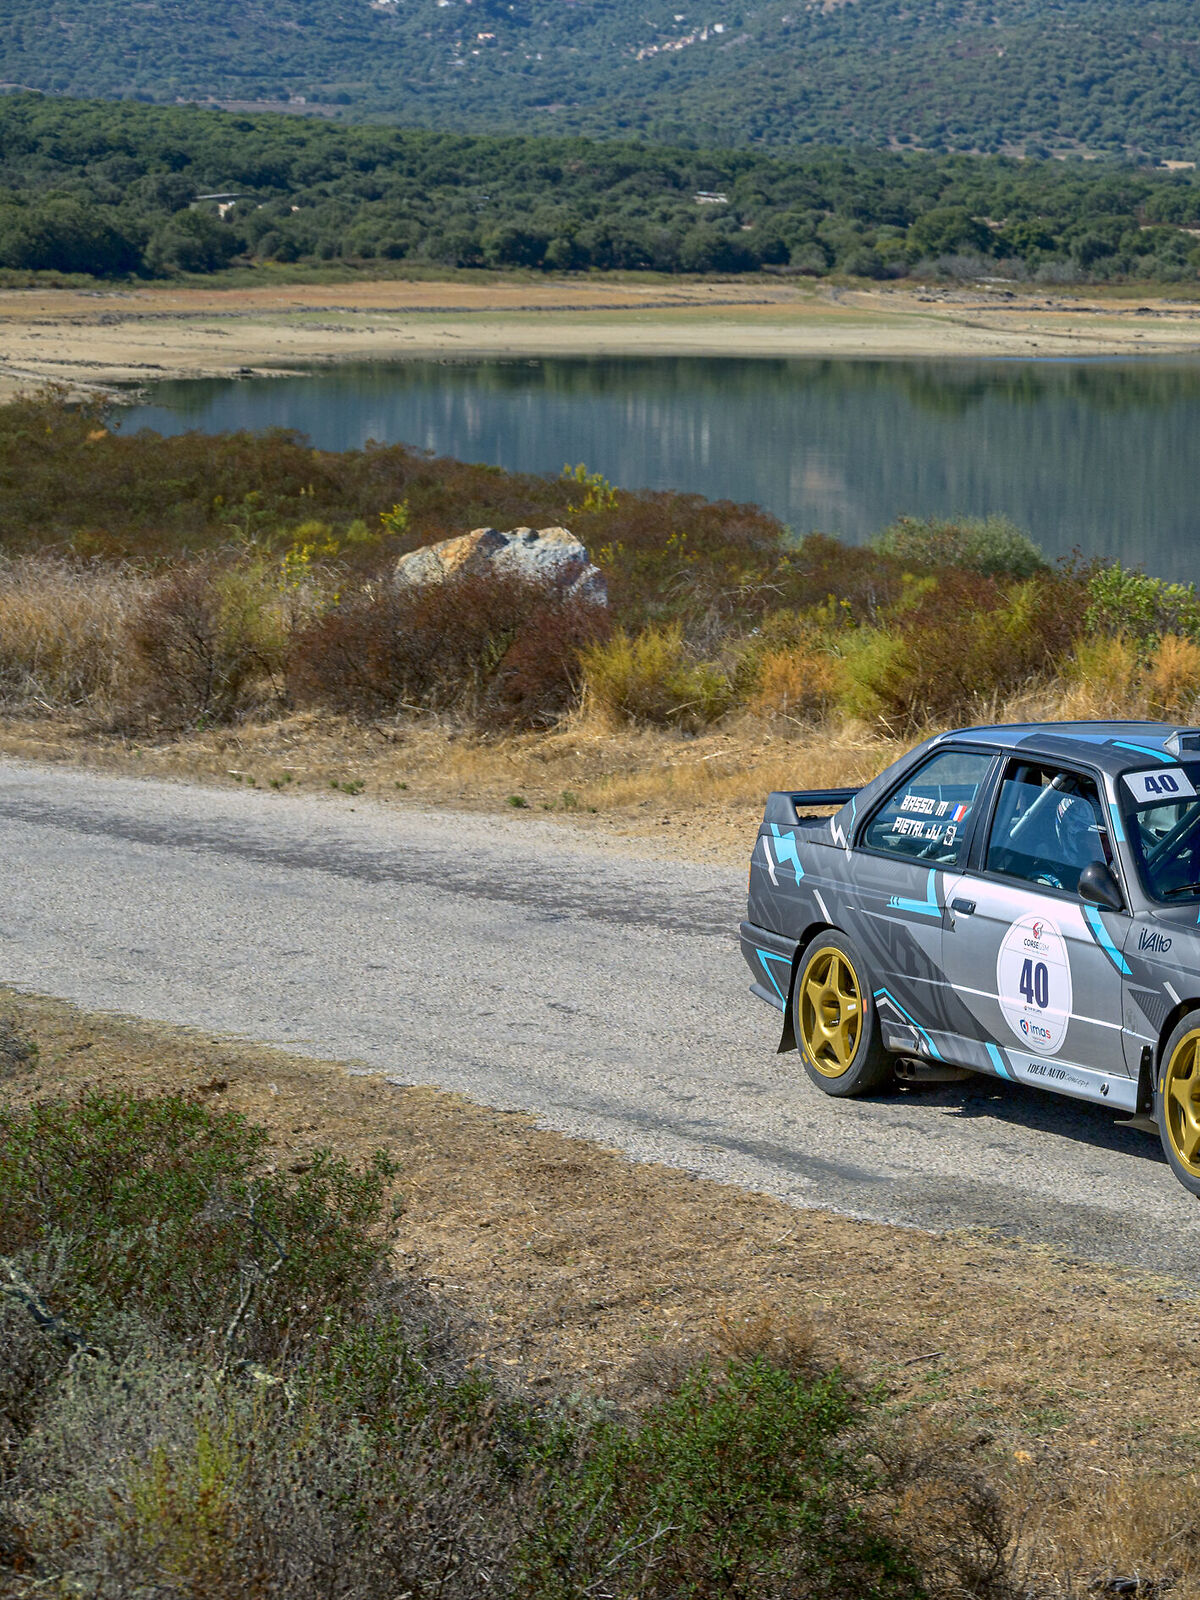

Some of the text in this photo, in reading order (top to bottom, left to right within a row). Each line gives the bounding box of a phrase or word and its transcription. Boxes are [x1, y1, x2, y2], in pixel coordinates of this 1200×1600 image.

[1144, 774, 1180, 794] 40
[935, 801, 949, 817] M
[1019, 958, 1049, 1009] 40
[1027, 1063, 1047, 1077] IDEAL
[1047, 1068, 1066, 1081] AUTO
